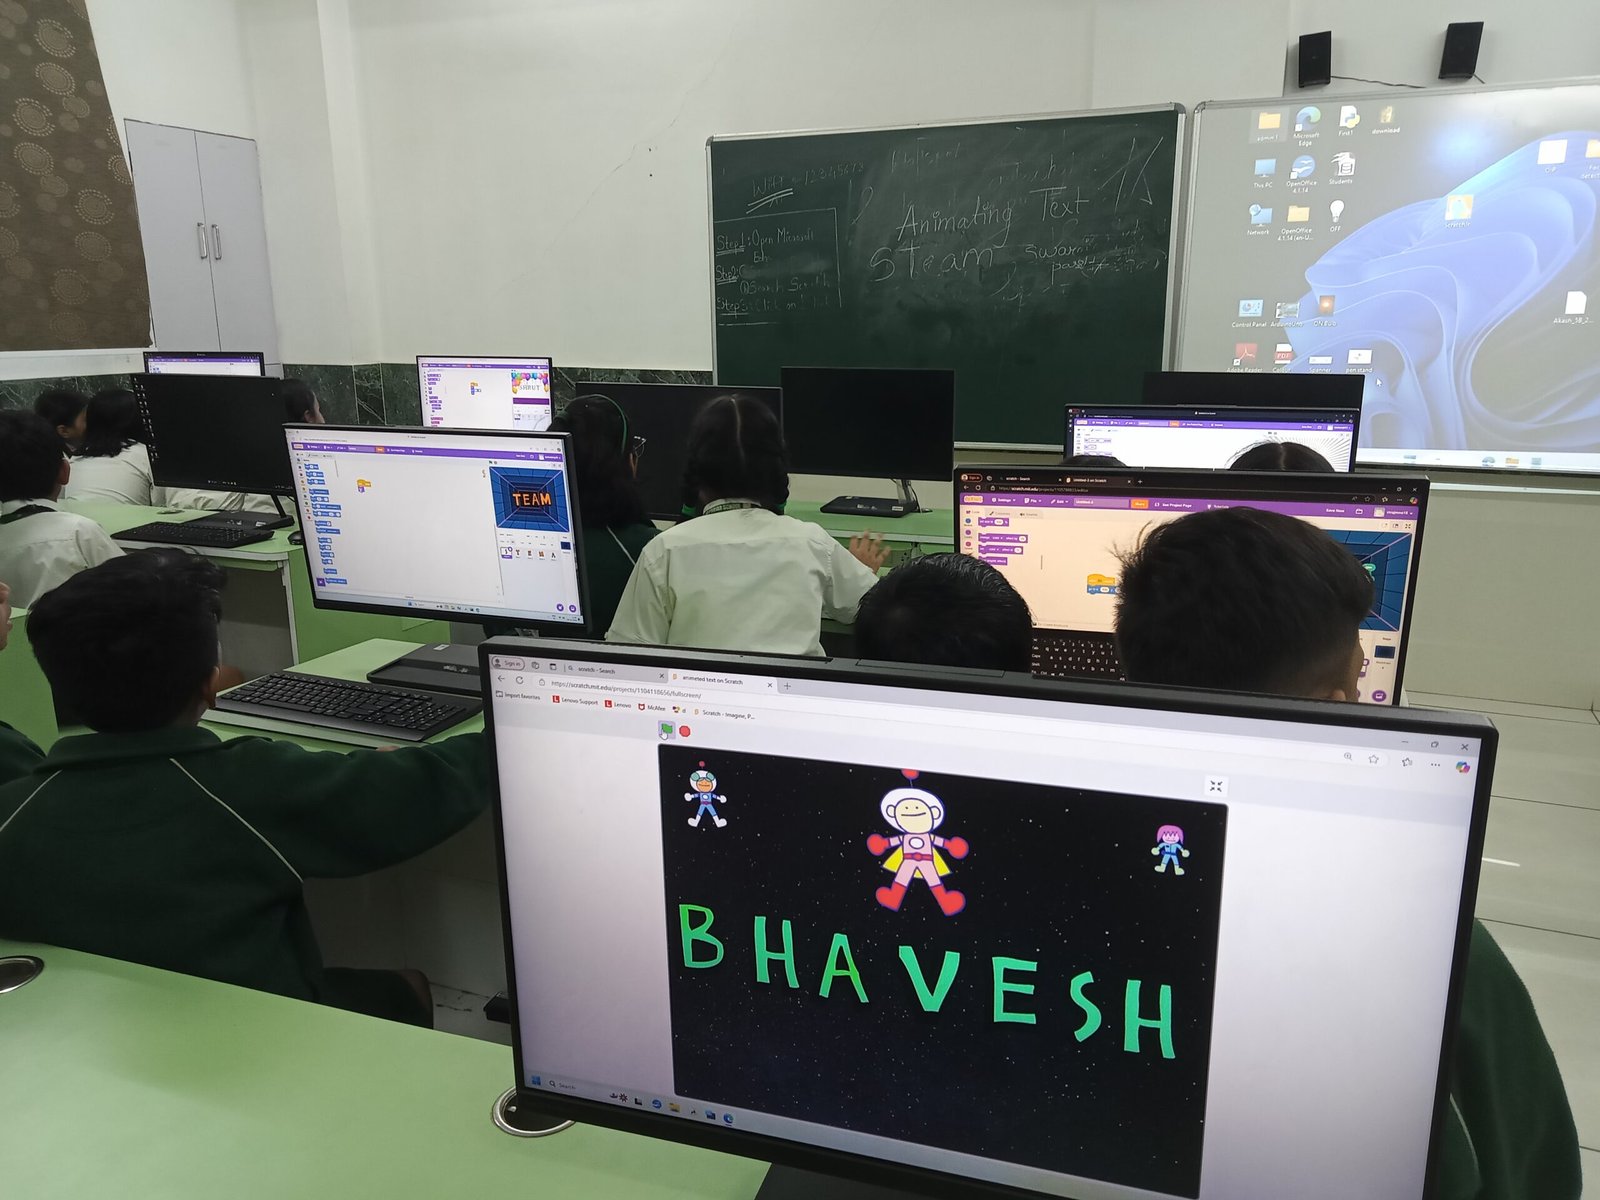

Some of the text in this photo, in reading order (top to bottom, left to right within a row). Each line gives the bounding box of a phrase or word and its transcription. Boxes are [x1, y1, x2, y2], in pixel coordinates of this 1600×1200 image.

[1292, 132, 1321, 140] Microsoft
[1298, 140, 1313, 148] Edge
[895, 186, 1091, 249] Animating Text
[512, 493, 553, 507] TEAM
[504, 692, 520, 700] Import
[579, 698, 599, 706] Support
[702, 709, 721, 717] Scratch
[678, 902, 1177, 1060] BHAVESH
